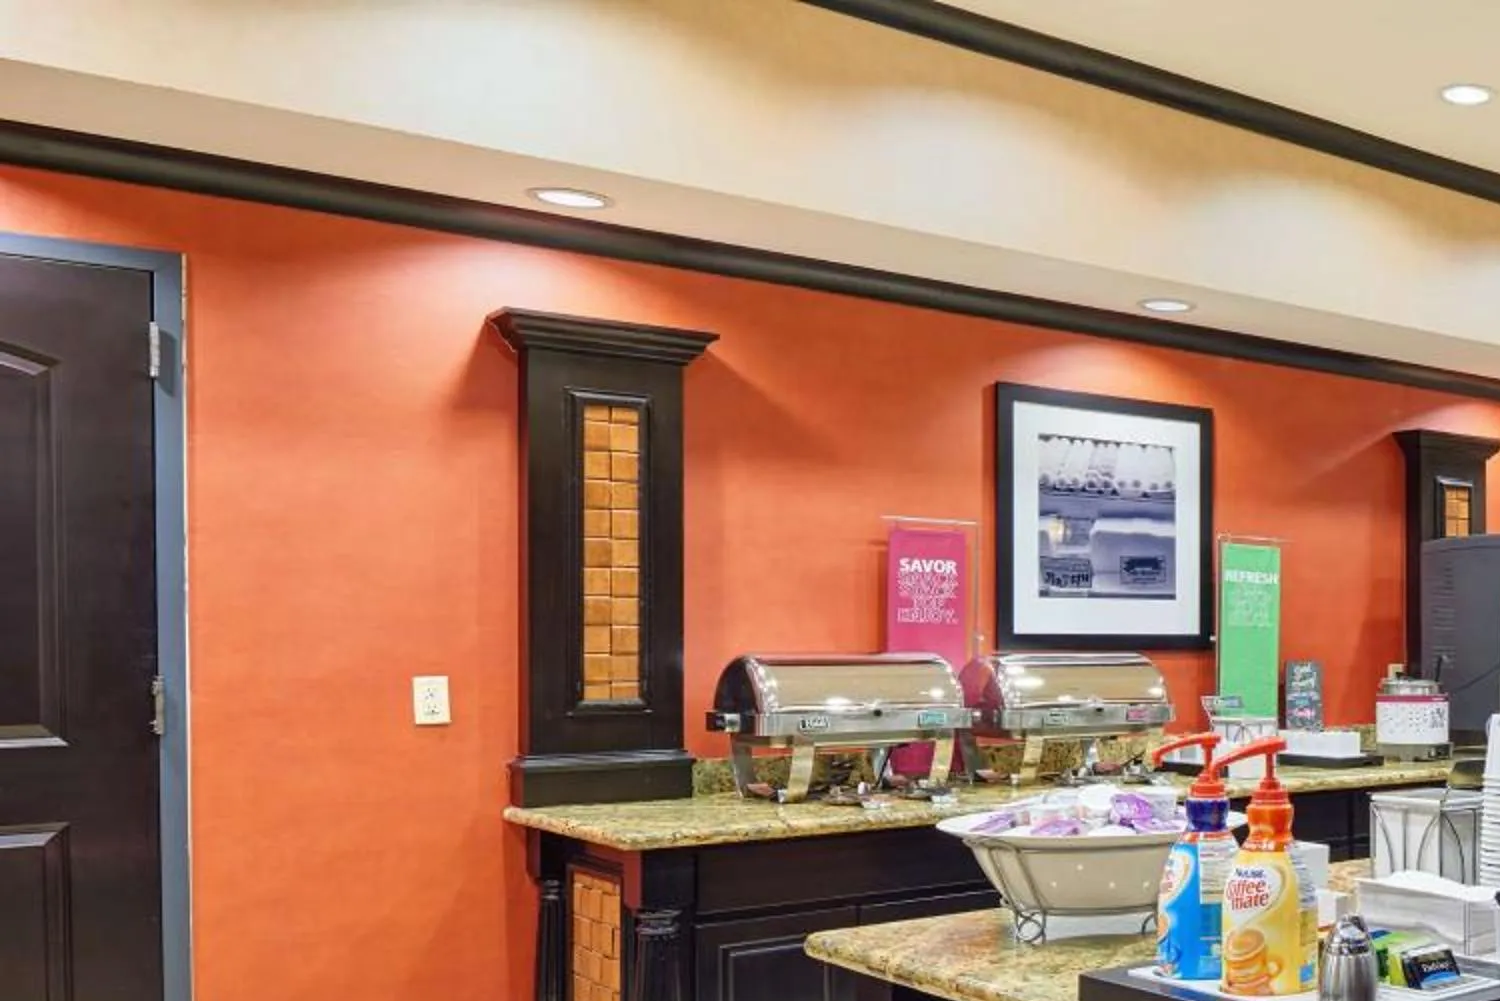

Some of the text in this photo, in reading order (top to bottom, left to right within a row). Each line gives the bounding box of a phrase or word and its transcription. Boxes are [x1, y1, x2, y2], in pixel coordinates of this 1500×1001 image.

[899, 558, 958, 575] SAVOR
[1224, 569, 1278, 585] REFRESH
[1231, 893, 1269, 911] mate
